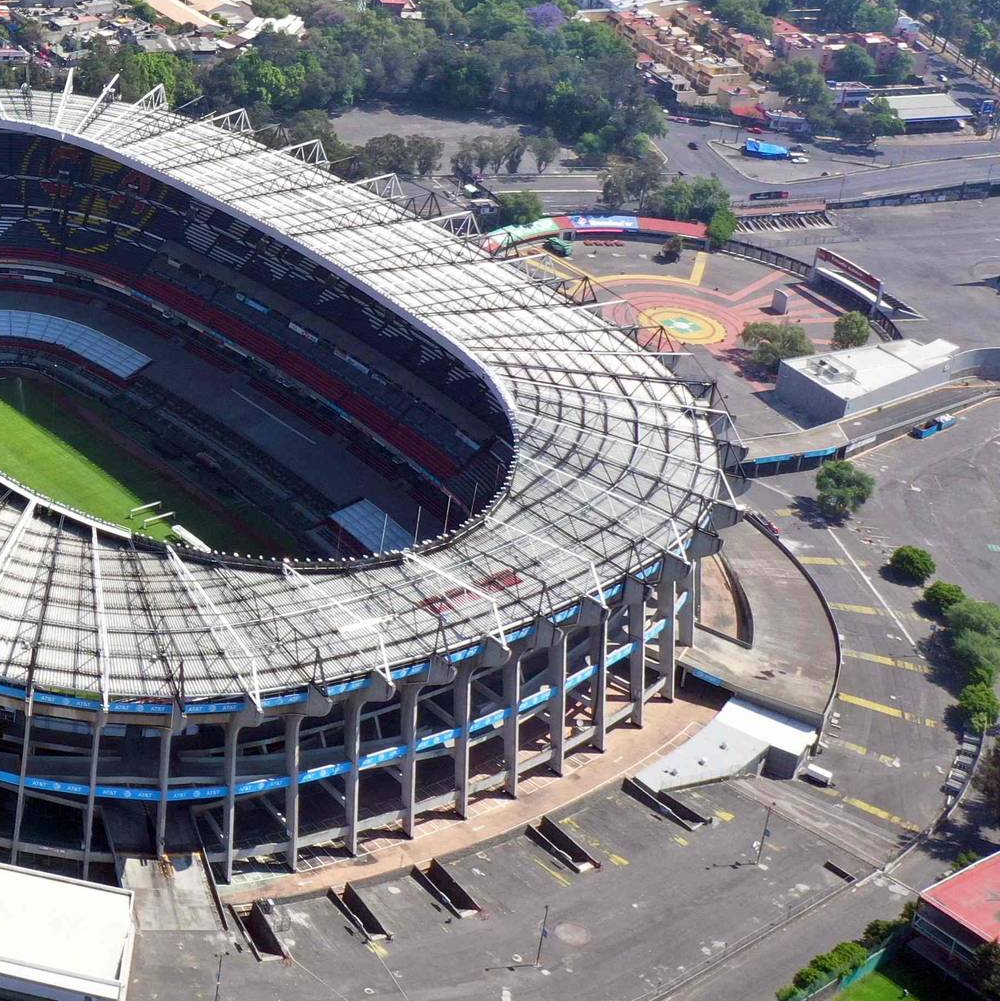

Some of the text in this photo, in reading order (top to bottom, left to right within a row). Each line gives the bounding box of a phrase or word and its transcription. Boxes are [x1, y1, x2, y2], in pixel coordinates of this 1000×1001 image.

[41, 694, 91, 709] AT&T AT&T
[188, 704, 237, 713] AT&T AT&T
[32, 780, 82, 793] AT&T AT&T
[103, 789, 153, 799] AT&T AT&T
[173, 789, 221, 800] AT&T AT&T
